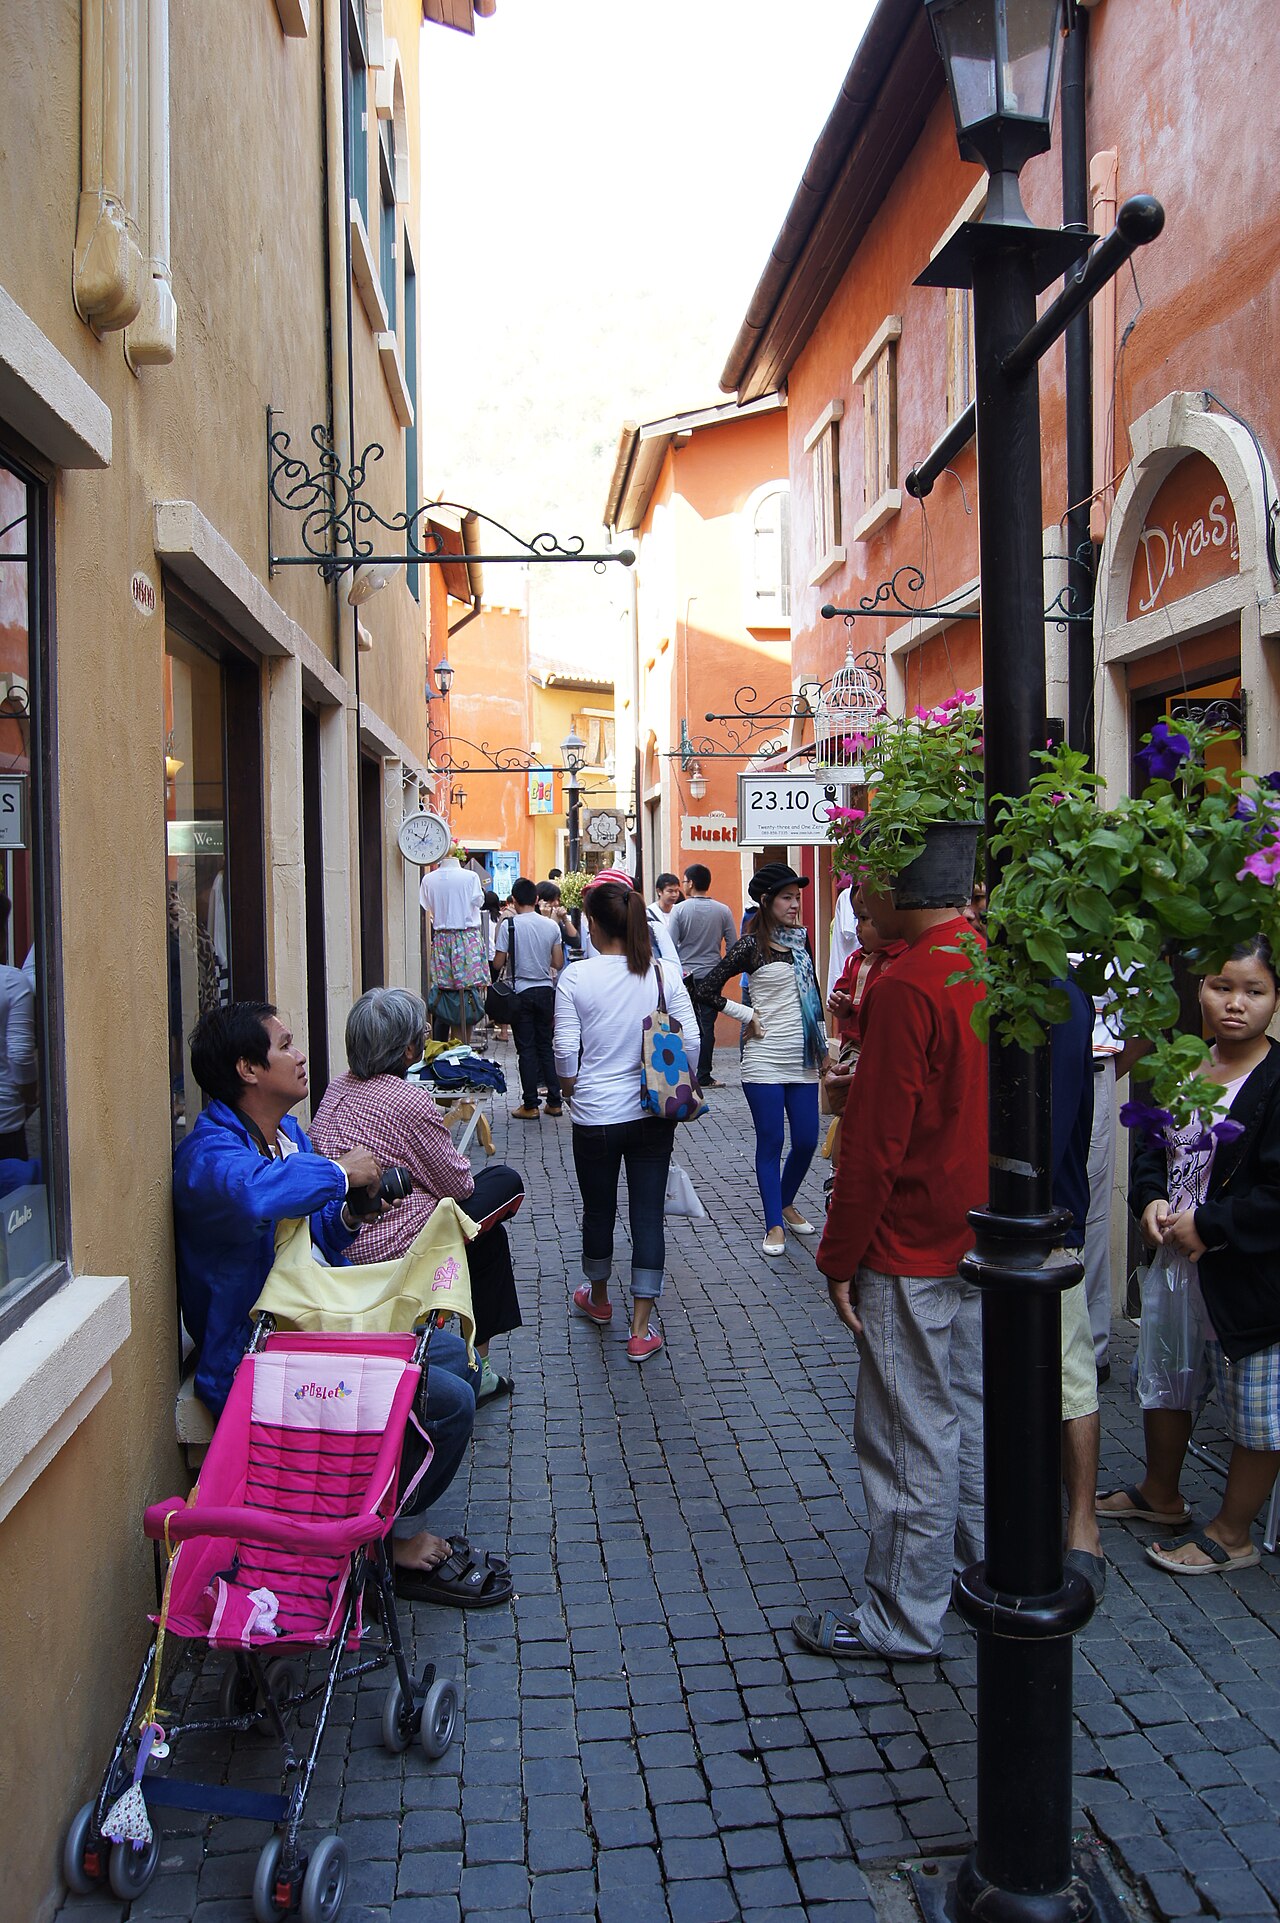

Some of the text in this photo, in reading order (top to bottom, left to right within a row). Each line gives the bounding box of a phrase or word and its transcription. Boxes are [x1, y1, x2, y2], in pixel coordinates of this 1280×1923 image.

[751, 790, 810, 811] 23.10
[193, 832, 223, 846] We...
[301, 1382, 340, 1400] Piglet
